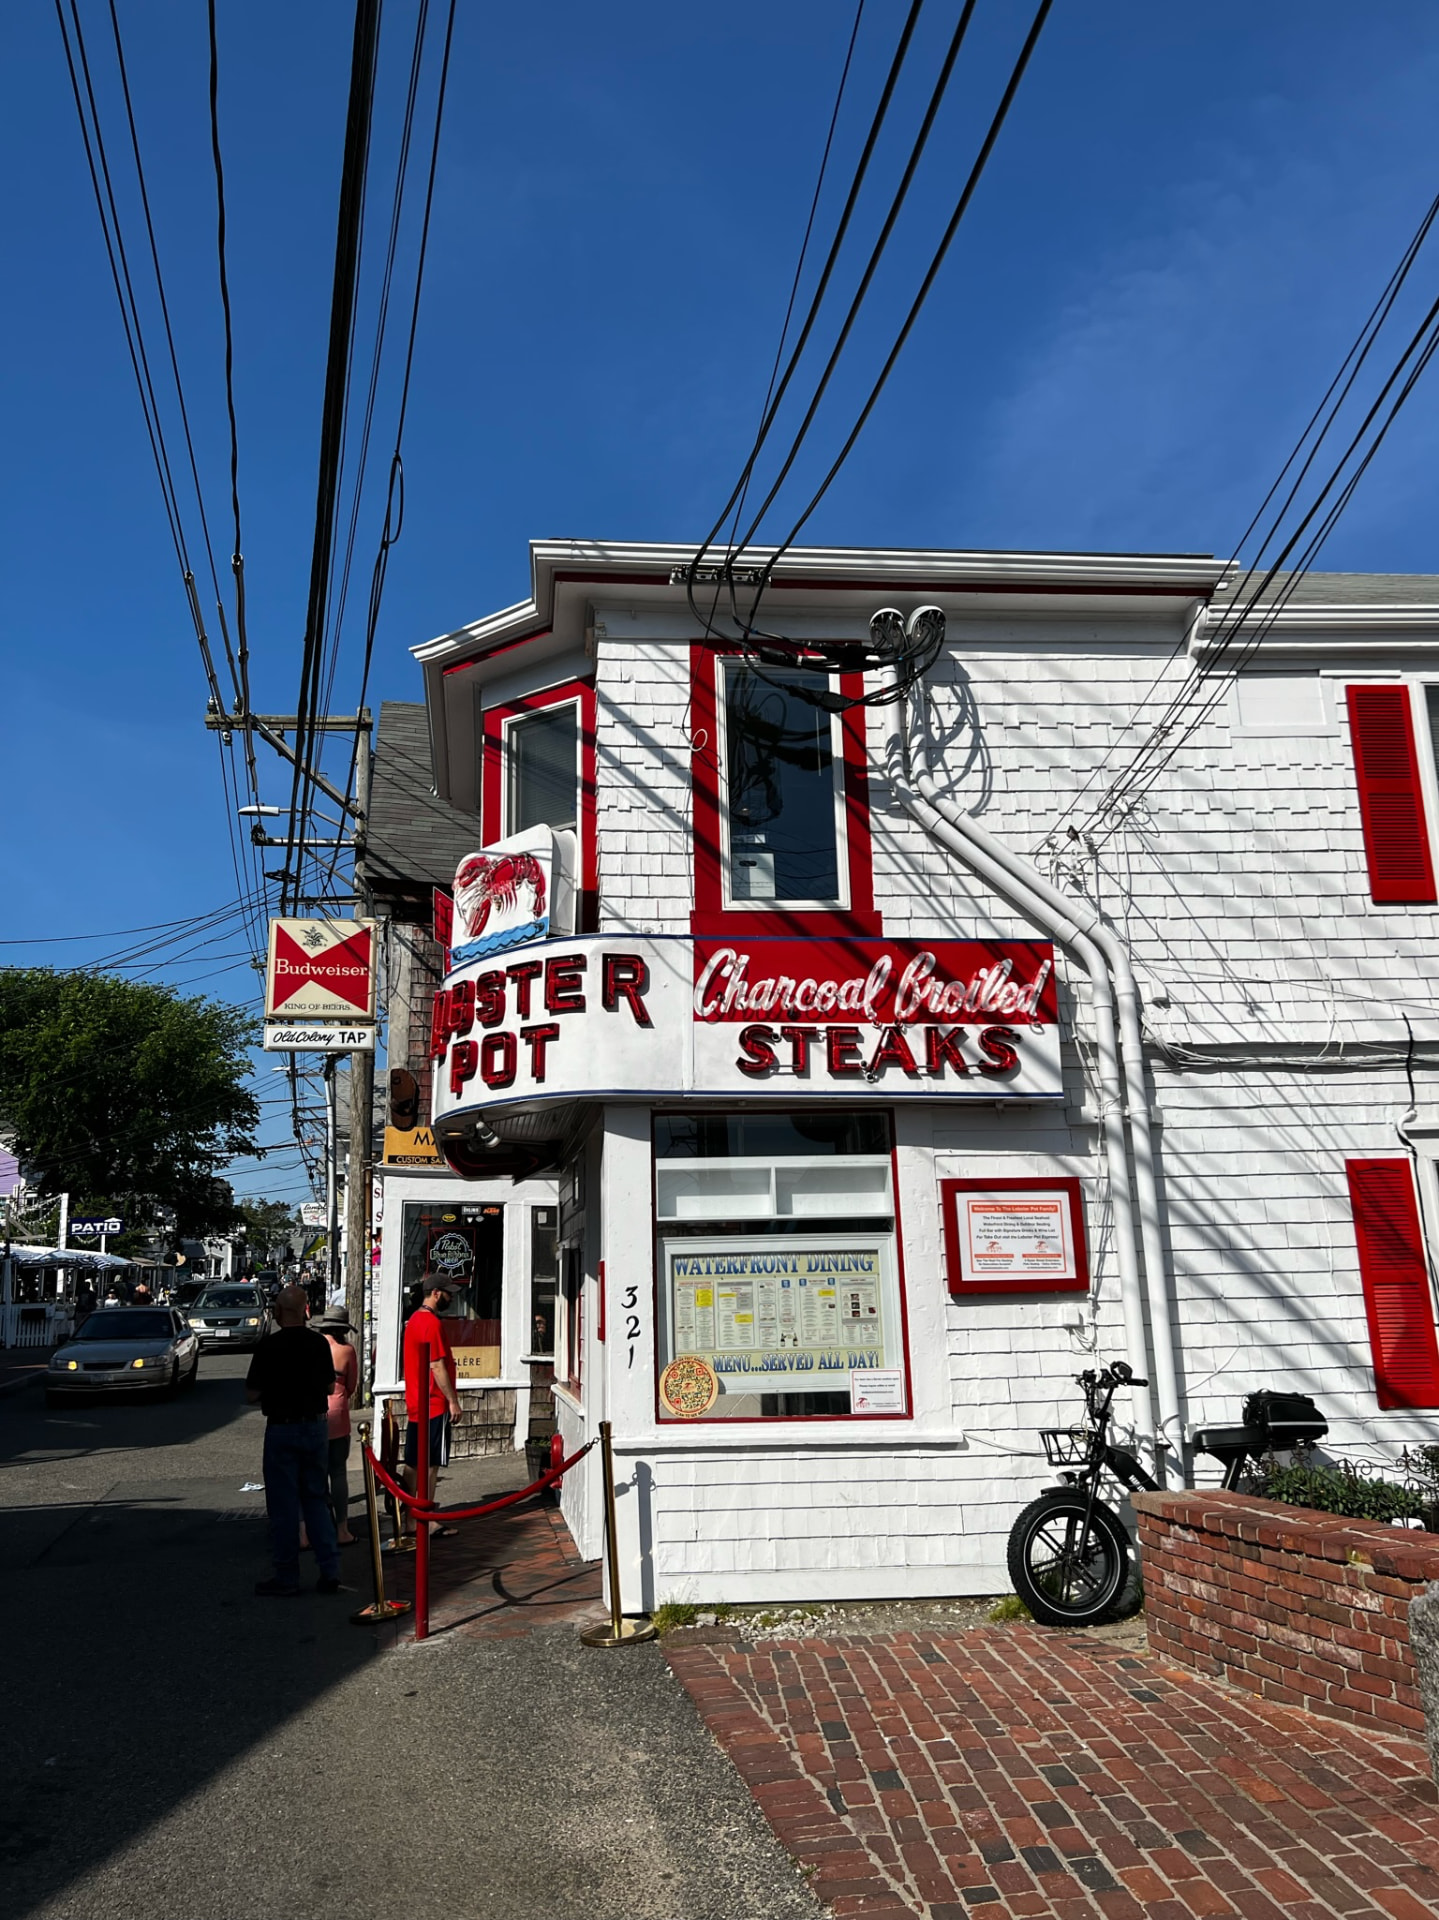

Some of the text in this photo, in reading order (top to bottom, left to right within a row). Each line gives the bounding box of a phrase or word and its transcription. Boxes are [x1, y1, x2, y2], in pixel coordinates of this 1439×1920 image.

[275, 958, 368, 976] Budweiser
[693, 948, 892, 1020] Charcoal
[273, 1031, 367, 1046] Old Colony TAP
[450, 1023, 560, 1093] POT
[735, 1024, 1022, 1073] STEAKS
[396, 1155, 428, 1164] CUSTOM
[71, 1222, 121, 1232] PATIO
[441, 1239, 462, 1251] Pabst
[674, 1252, 874, 1276] WATERFRONT DINING
[818, 1351, 845, 1370] ALL
[847, 1350, 879, 1369] DAY!
